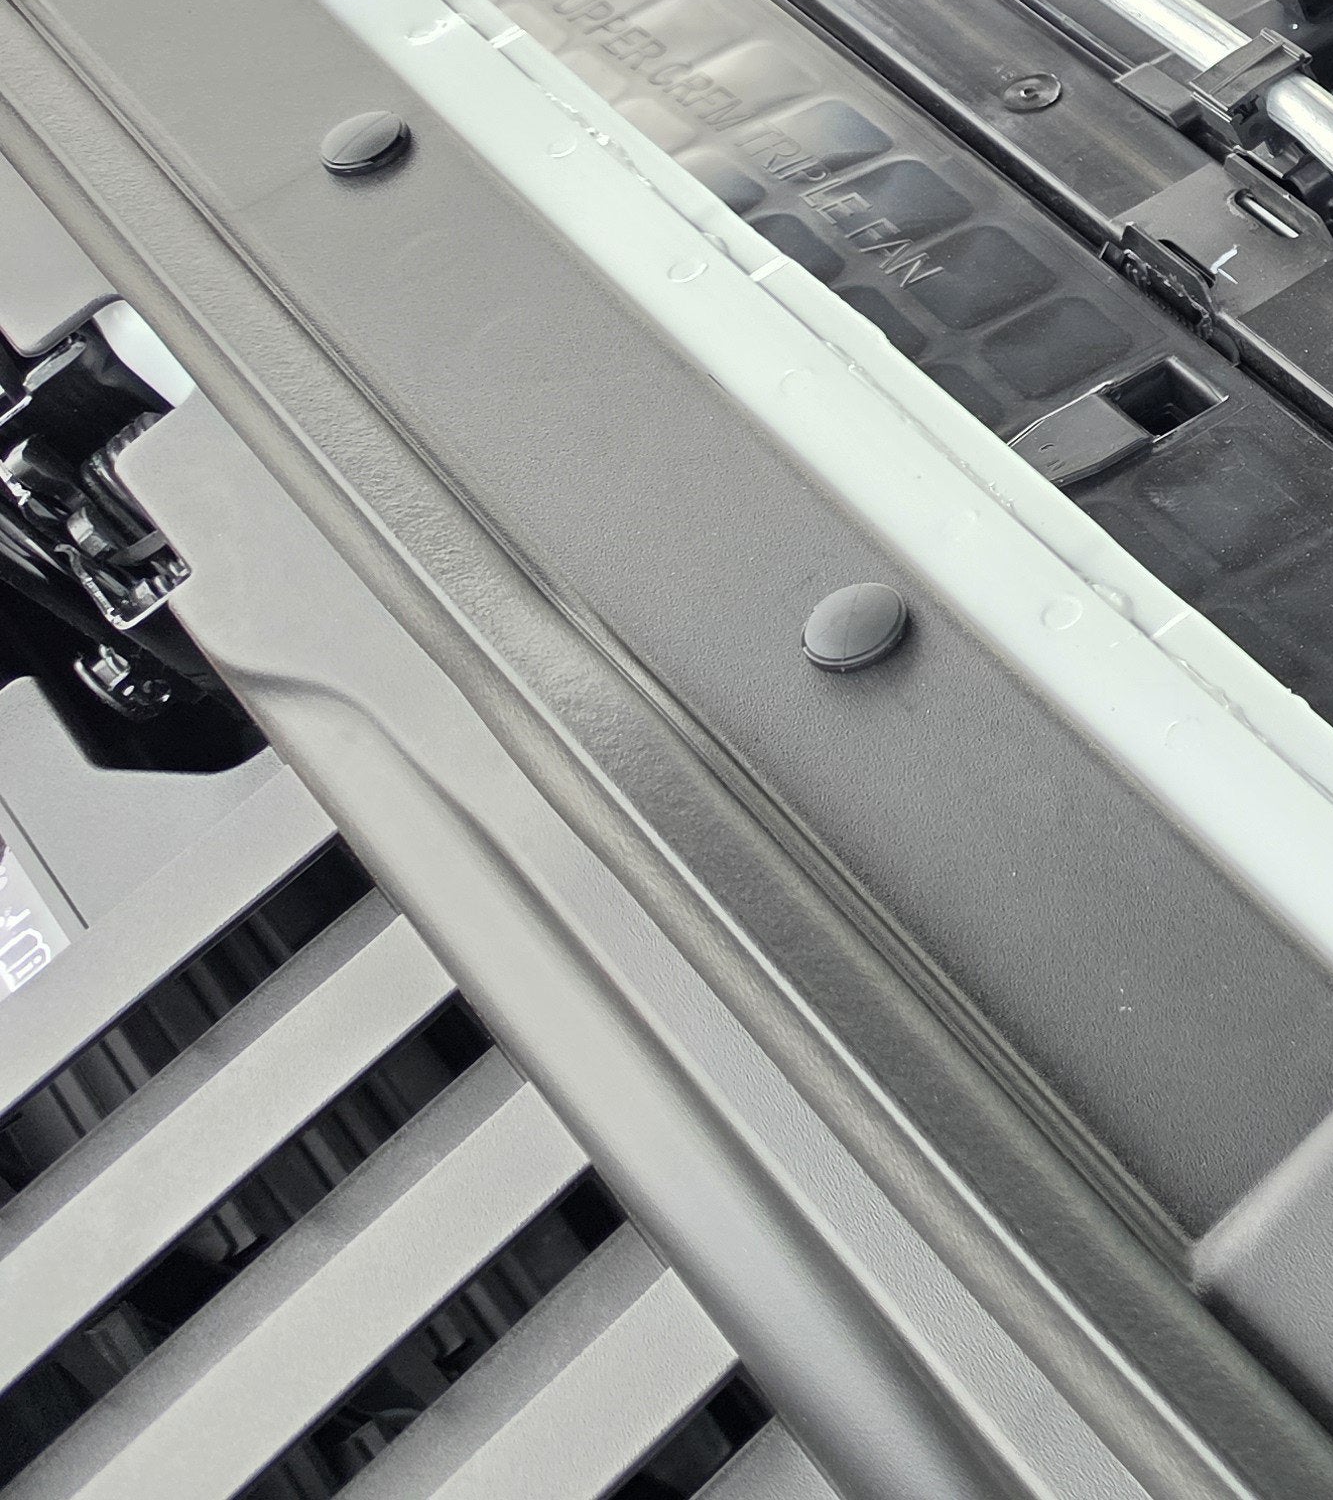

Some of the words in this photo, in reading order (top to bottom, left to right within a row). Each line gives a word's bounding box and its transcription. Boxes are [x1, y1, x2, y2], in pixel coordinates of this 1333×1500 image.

[648, 62, 752, 132] CRFM
[736, 123, 873, 225] TRIPLE
[845, 218, 943, 288] FAN
